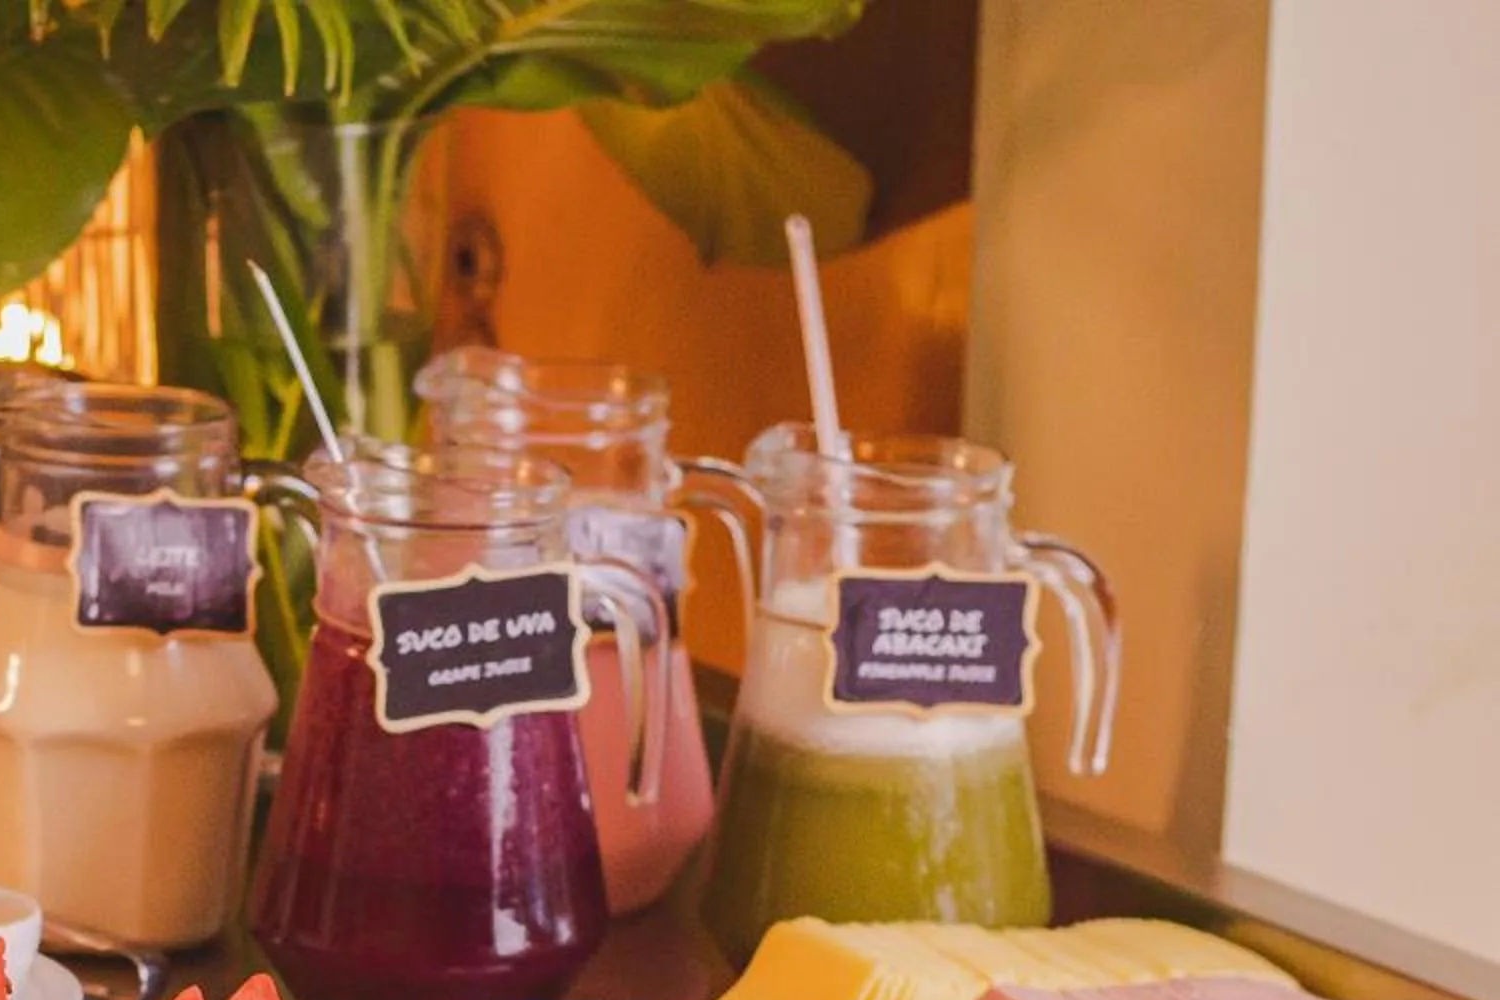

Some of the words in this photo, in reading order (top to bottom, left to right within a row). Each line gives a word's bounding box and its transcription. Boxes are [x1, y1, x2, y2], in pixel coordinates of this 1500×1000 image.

[396, 624, 463, 654] SUCO
[467, 618, 500, 643] DE
[505, 610, 556, 638] UVA
[878, 607, 944, 632] SUCO
[948, 609, 983, 633] DE
